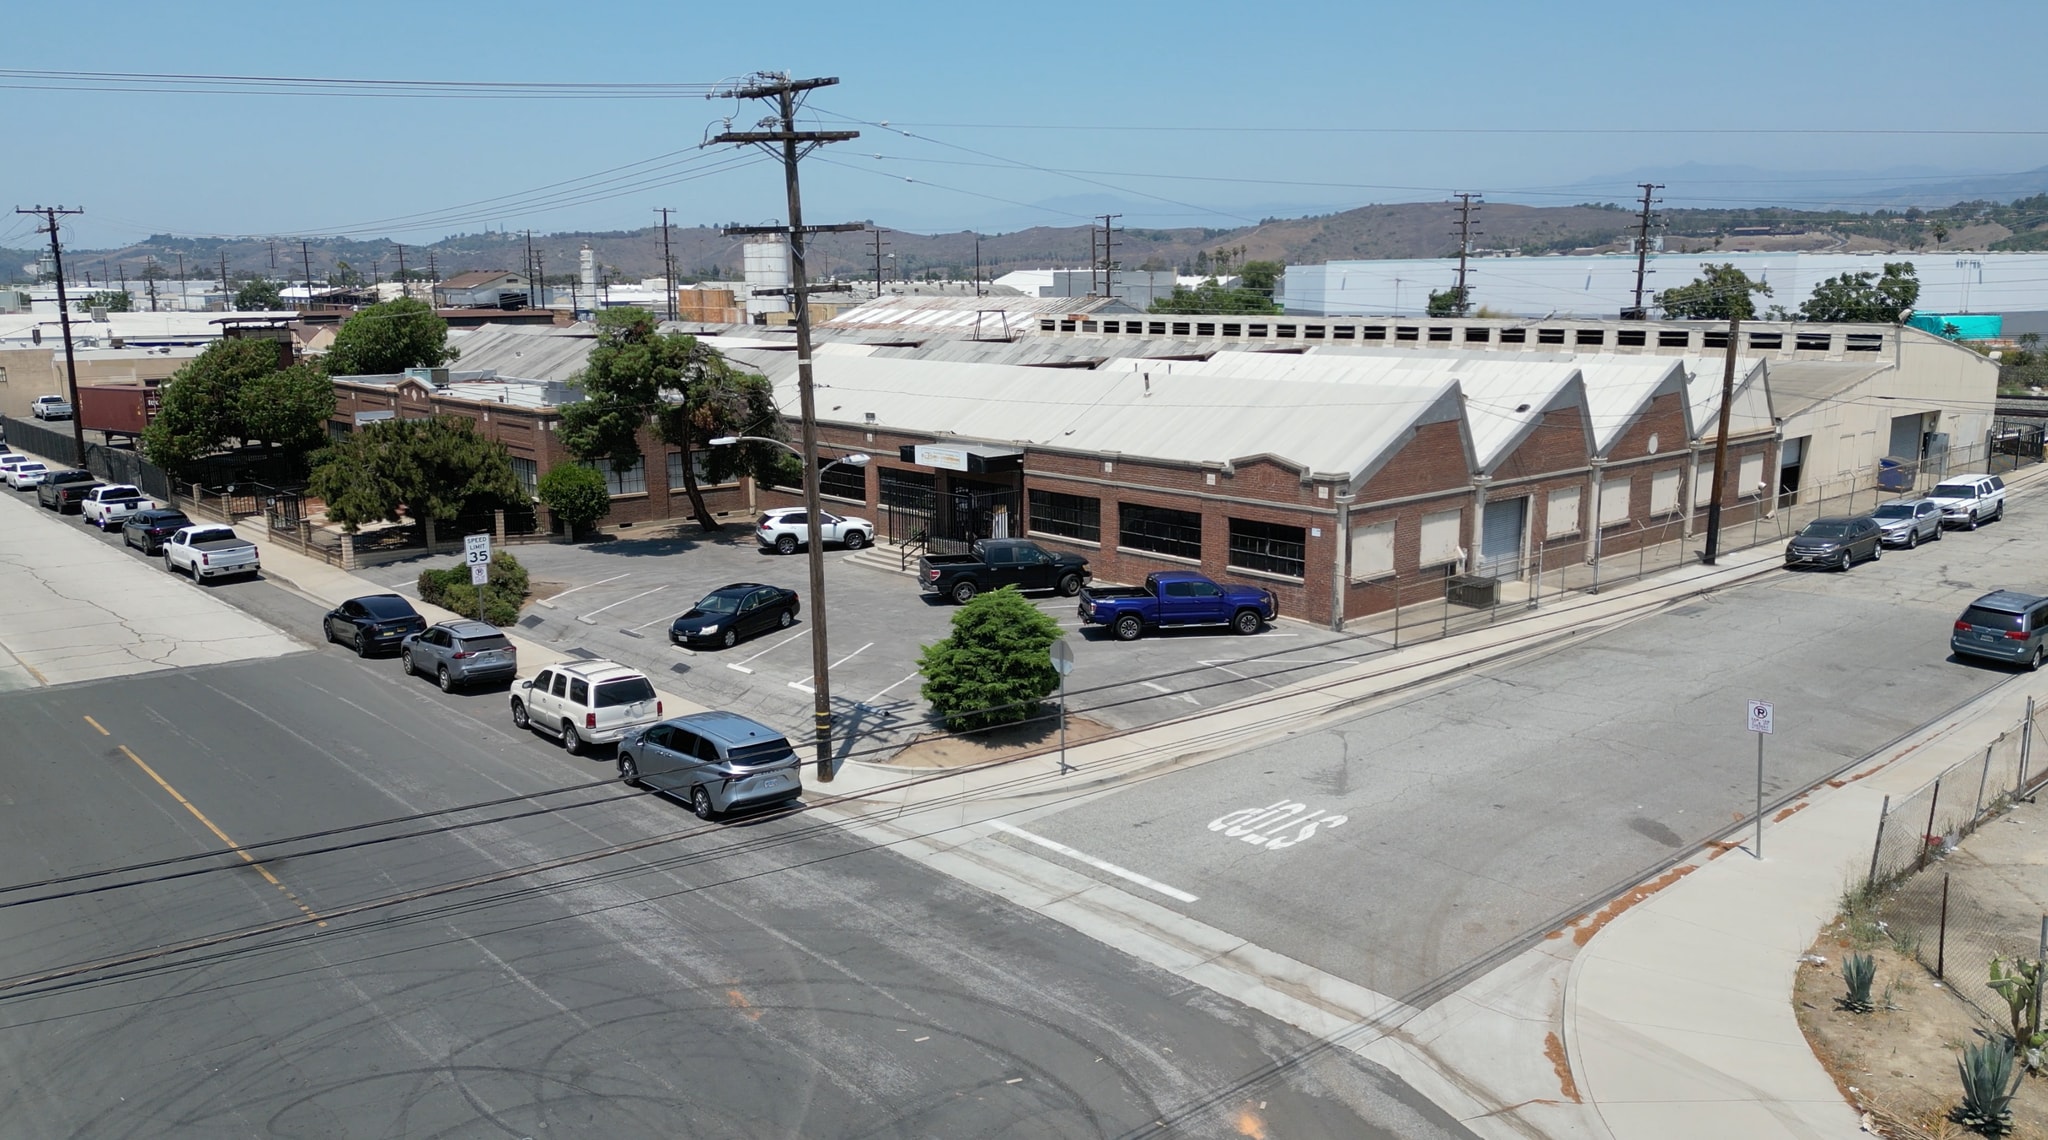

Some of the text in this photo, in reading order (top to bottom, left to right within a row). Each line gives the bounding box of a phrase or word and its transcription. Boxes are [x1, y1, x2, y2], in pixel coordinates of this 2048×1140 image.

[467, 536, 487, 544] SPEED
[469, 550, 488, 563] 35
[1207, 799, 1349, 850] STOP
